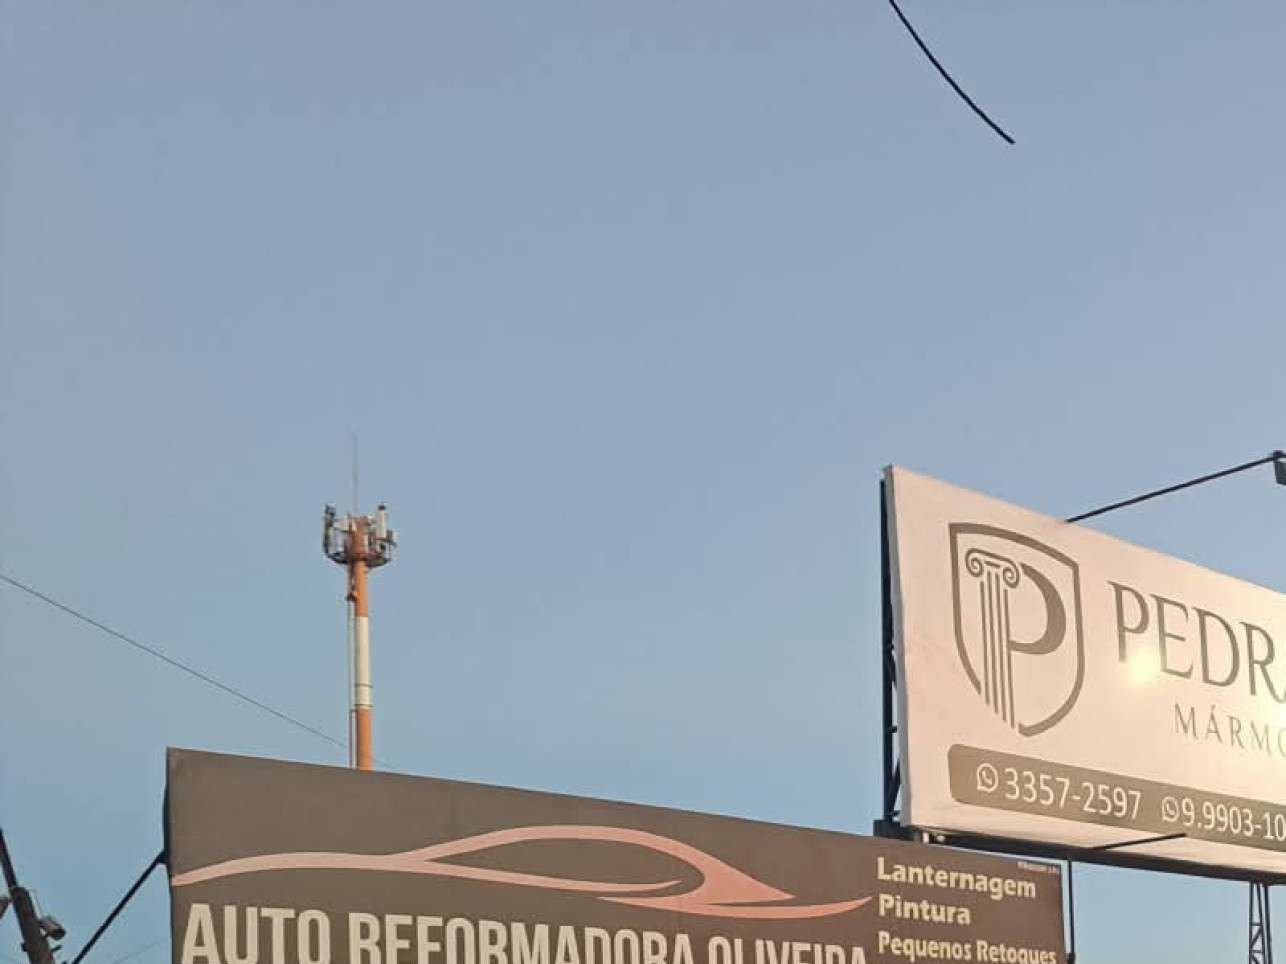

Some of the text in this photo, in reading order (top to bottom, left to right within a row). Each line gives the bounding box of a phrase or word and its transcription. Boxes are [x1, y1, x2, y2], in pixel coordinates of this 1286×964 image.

[1004, 766, 1142, 820] 3357-2597
[876, 856, 1036, 900] Lanternagem
[877, 893, 971, 925] Pintura
[877, 930, 972, 963] Pequenos
